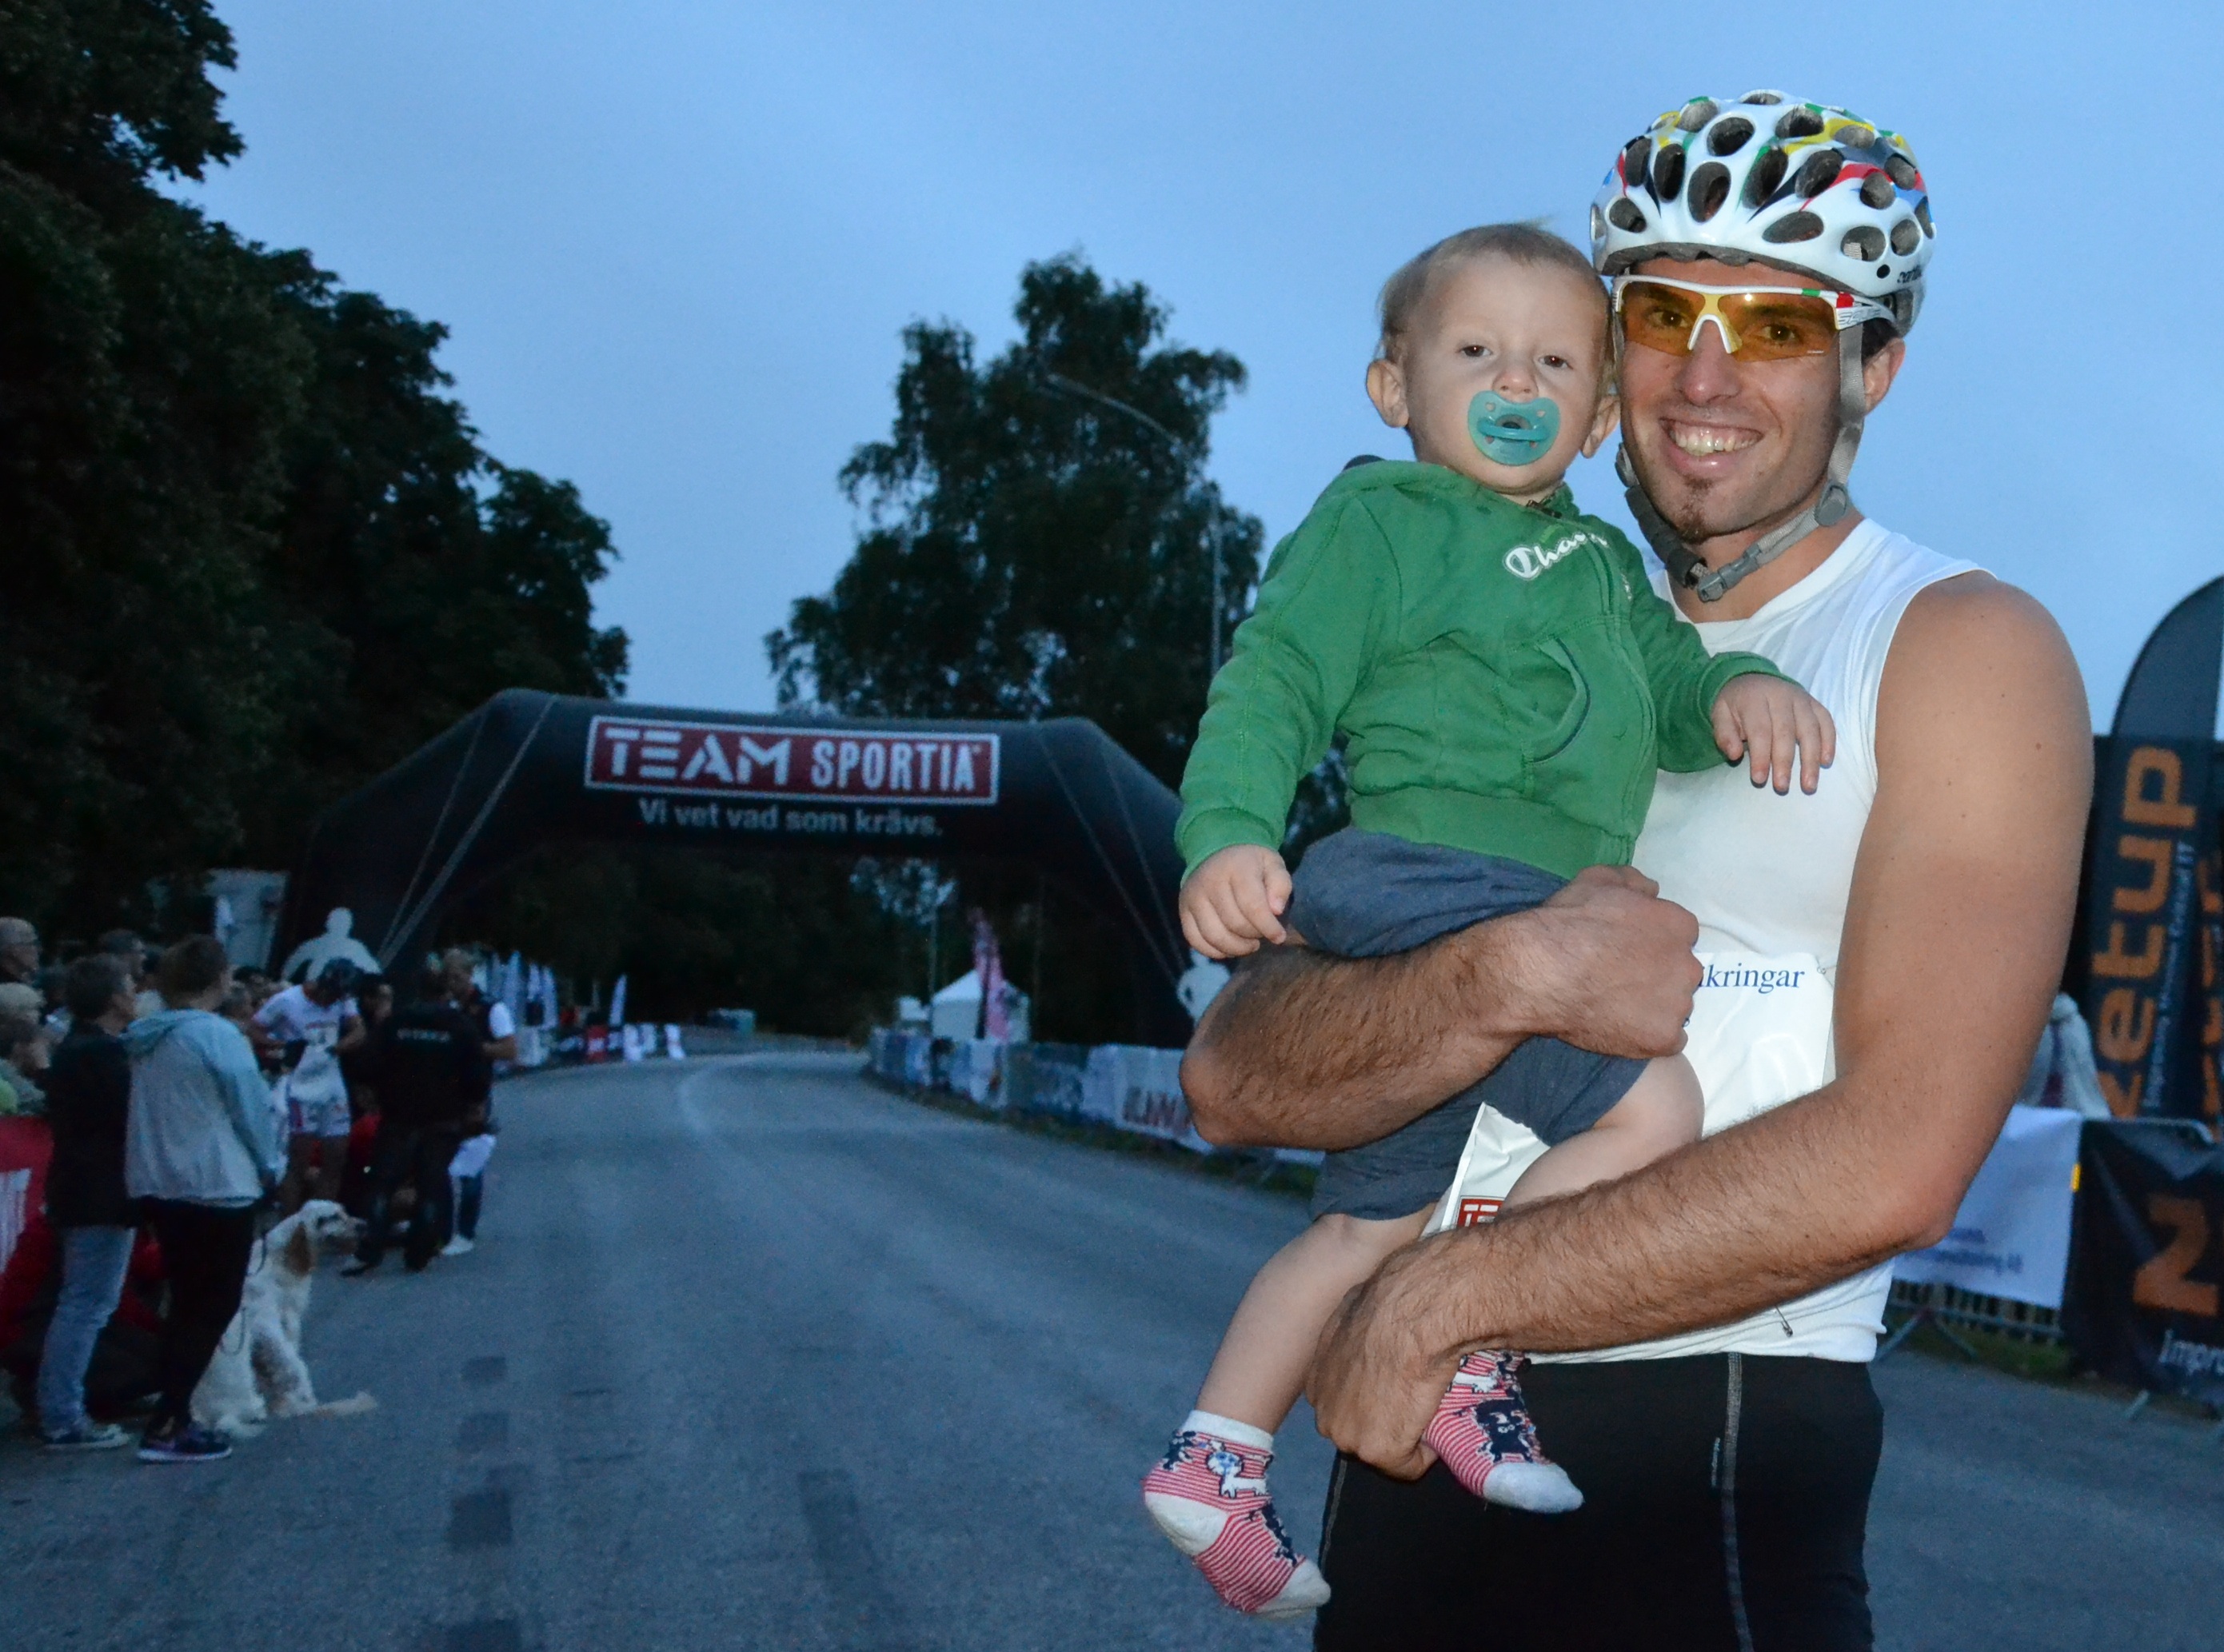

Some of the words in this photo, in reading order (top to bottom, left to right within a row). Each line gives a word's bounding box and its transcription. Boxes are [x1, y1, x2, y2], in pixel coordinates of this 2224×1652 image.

[605, 728, 790, 785] TEAM
[811, 740, 975, 792] SPORTIA
[639, 799, 668, 824] Vi
[674, 802, 718, 829] vet
[726, 804, 780, 831] vad
[785, 811, 848, 833] som
